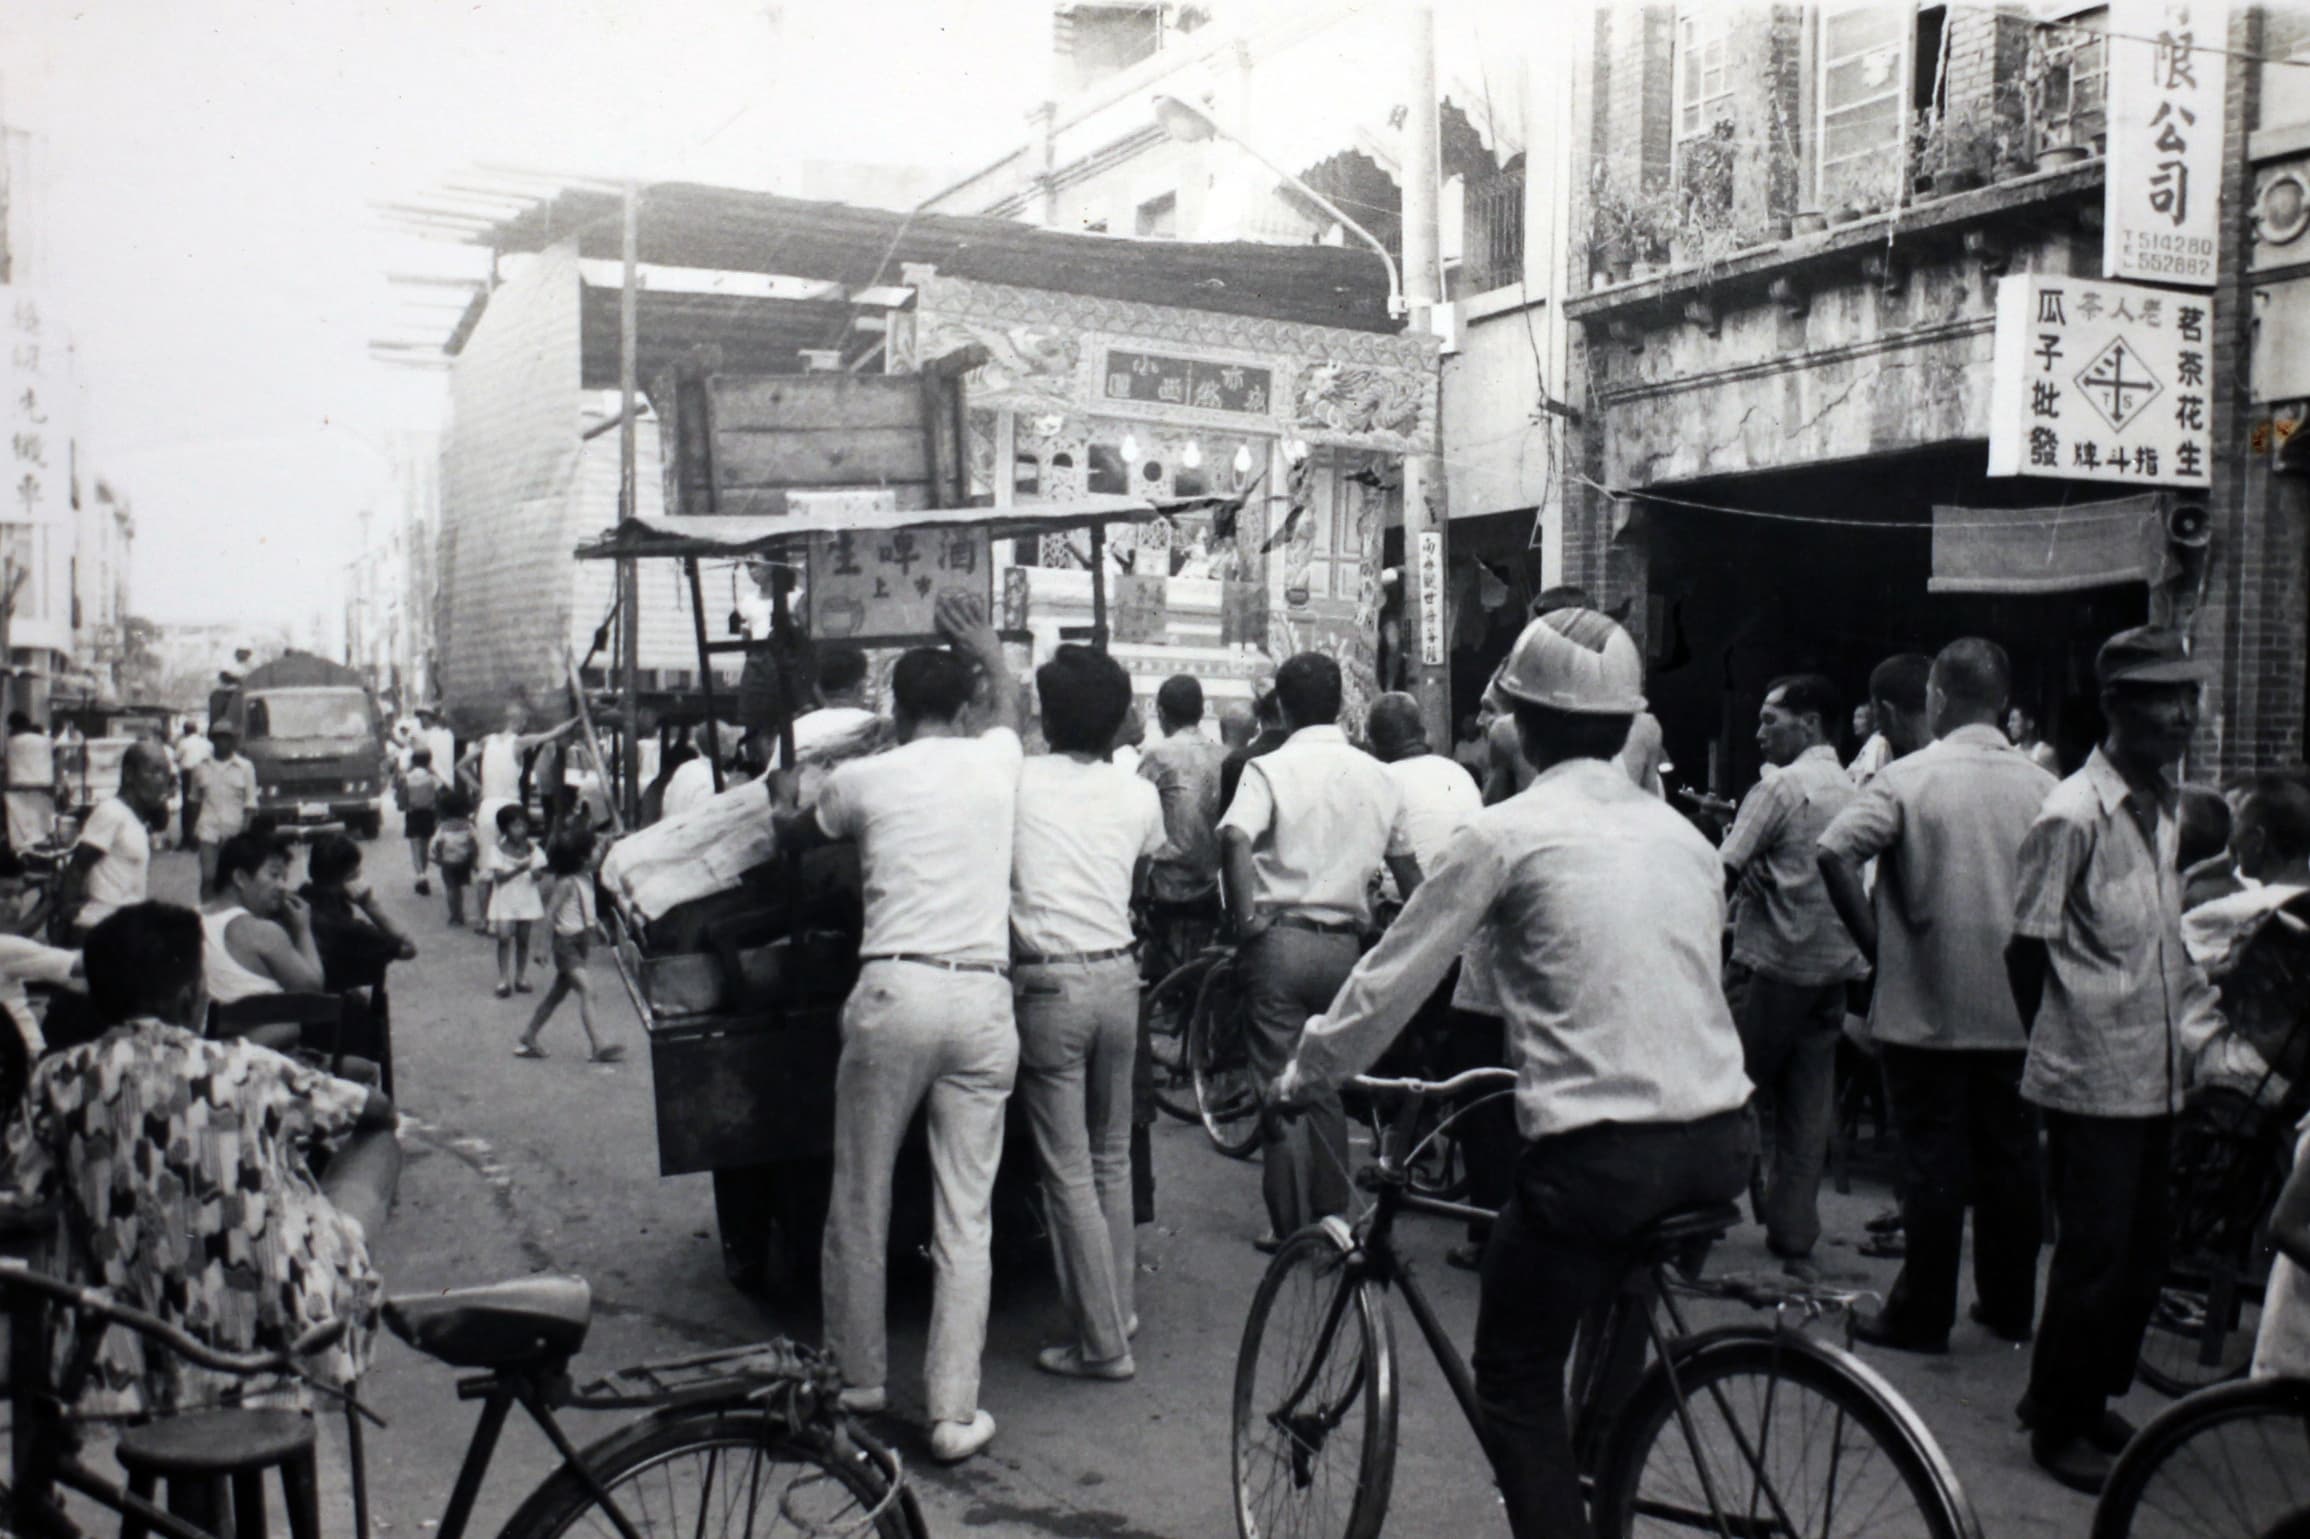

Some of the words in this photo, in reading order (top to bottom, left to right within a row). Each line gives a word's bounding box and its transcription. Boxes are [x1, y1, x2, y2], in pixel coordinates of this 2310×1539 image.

[2077, 292, 2163, 327] 老人茶
[2030, 289, 2067, 466] 瓜子批發
[2175, 306, 2205, 477] 茗茶花生
[2074, 443, 2159, 476] 指斗牌
[827, 531, 975, 576] 生啤酒
